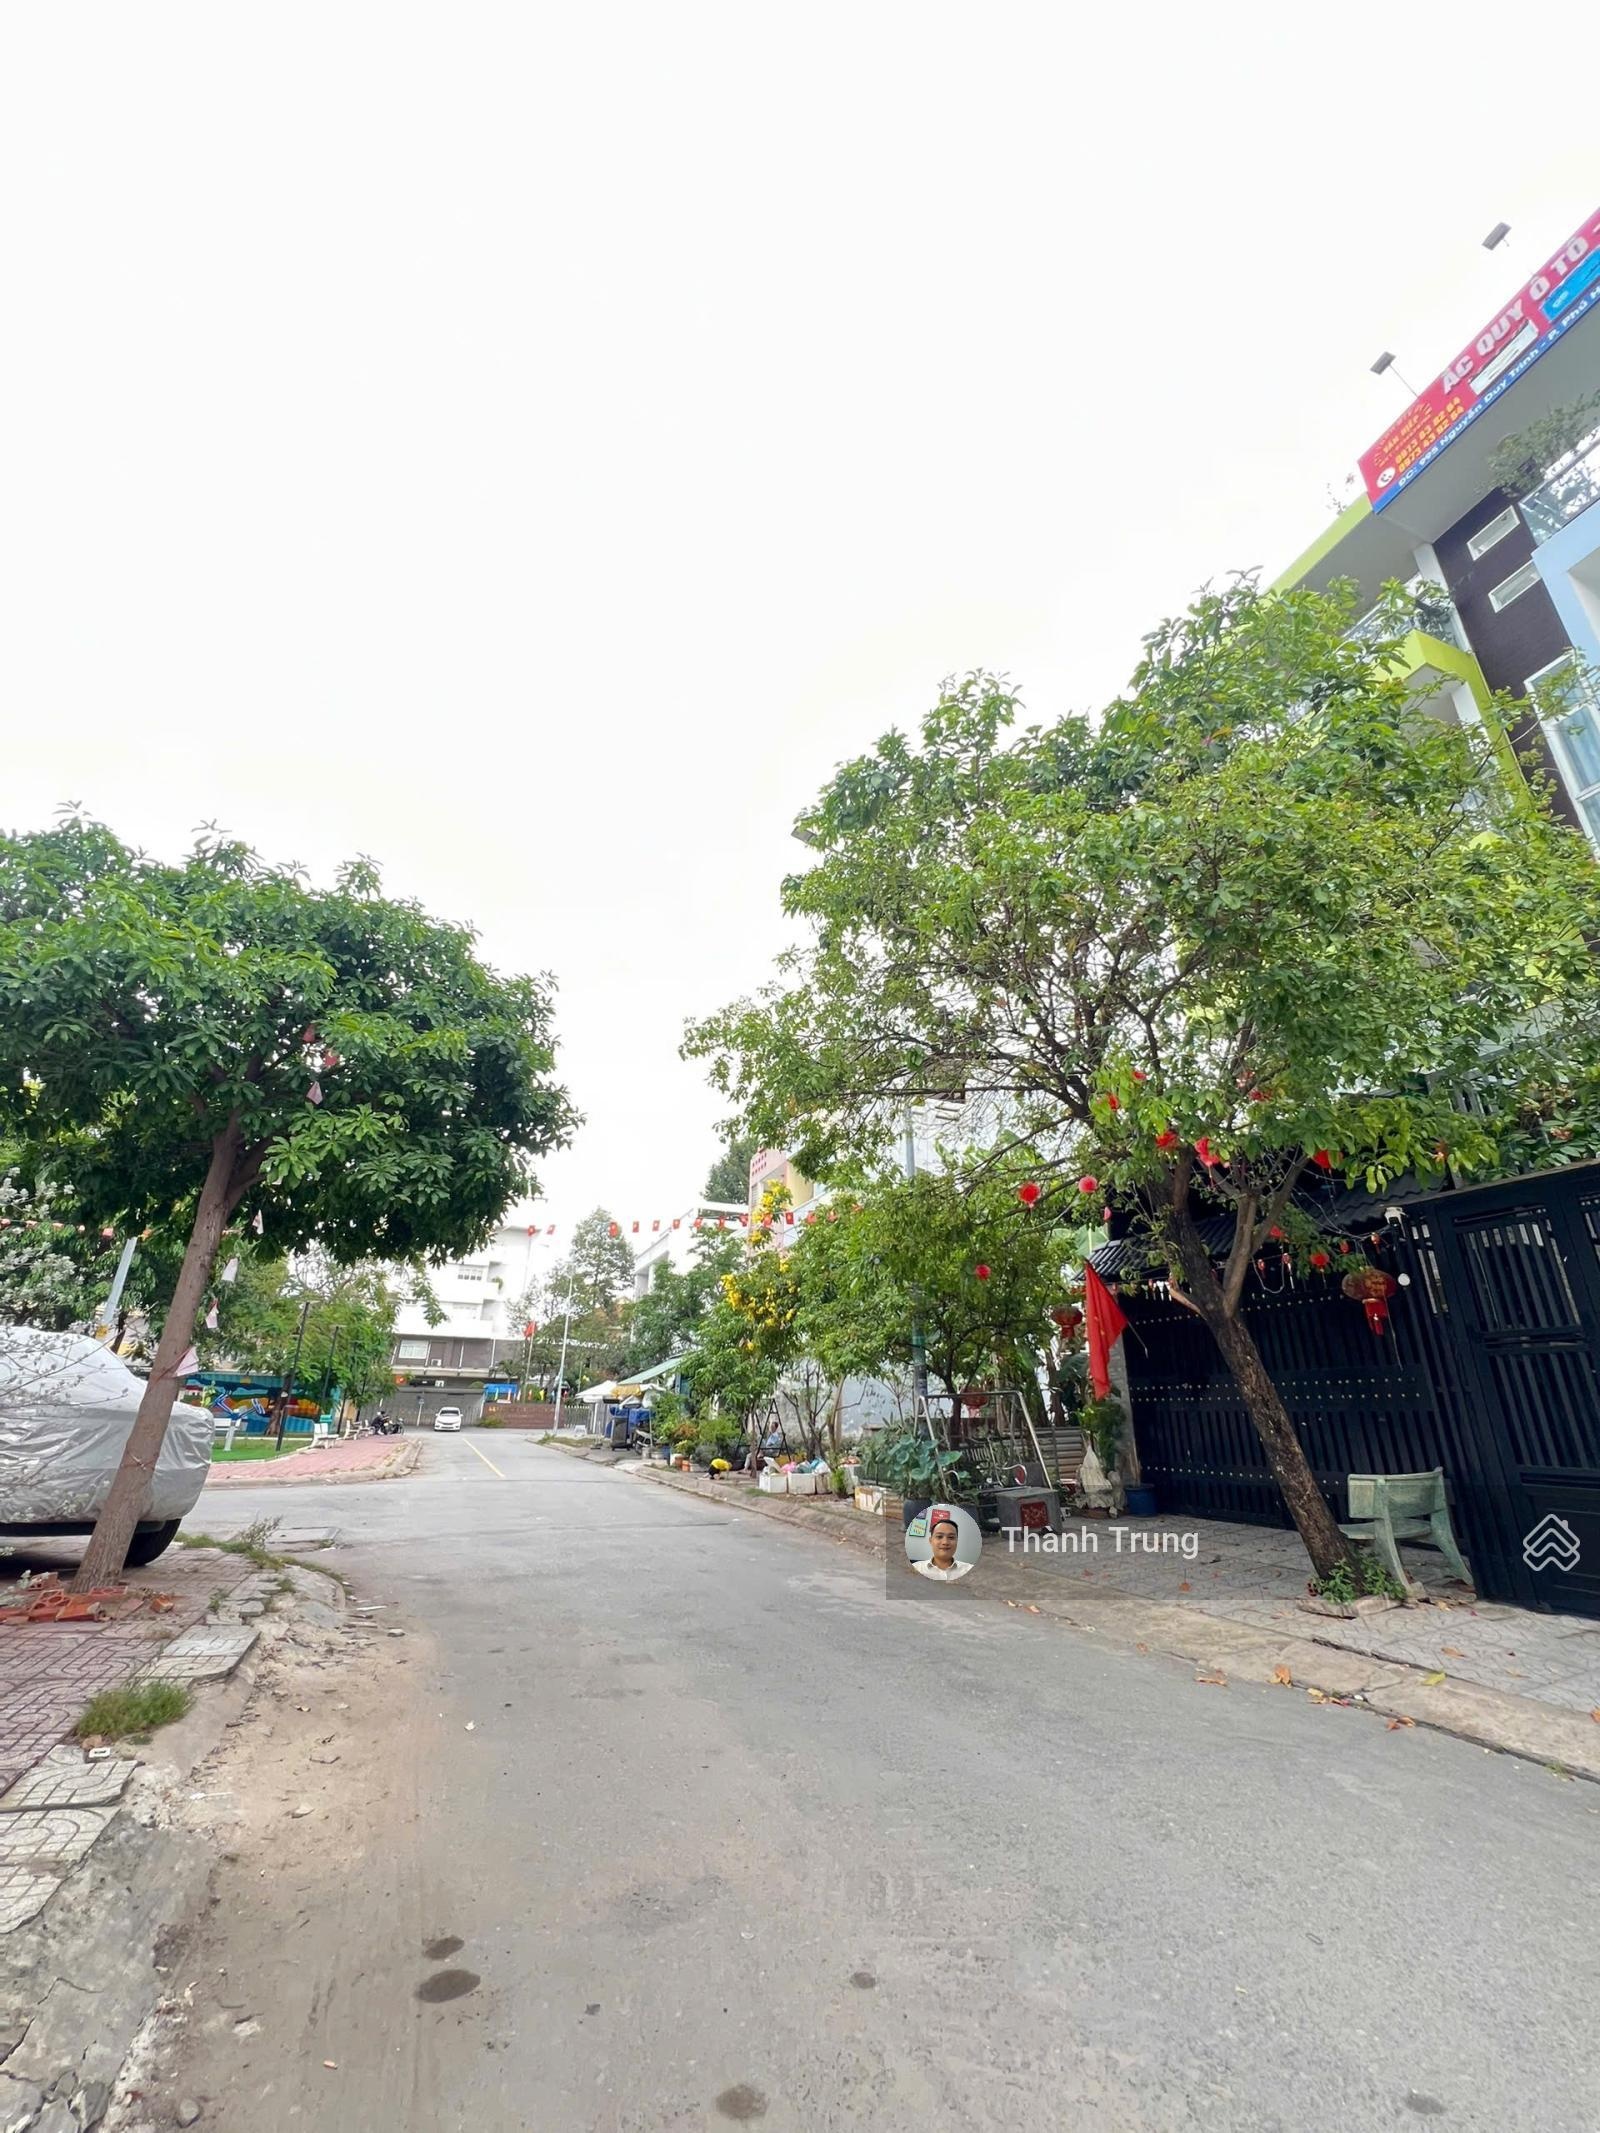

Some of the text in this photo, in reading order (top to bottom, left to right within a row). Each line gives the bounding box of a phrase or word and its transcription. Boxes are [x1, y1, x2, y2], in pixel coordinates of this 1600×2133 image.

[1476, 298, 1524, 356] QUY
[1529, 273, 1550, 300] Ô
[1550, 235, 1588, 276] TÔ
[1440, 404, 1483, 446] Nguyễn
[1484, 379, 1507, 403] Duy
[1561, 300, 1588, 327] Phú
